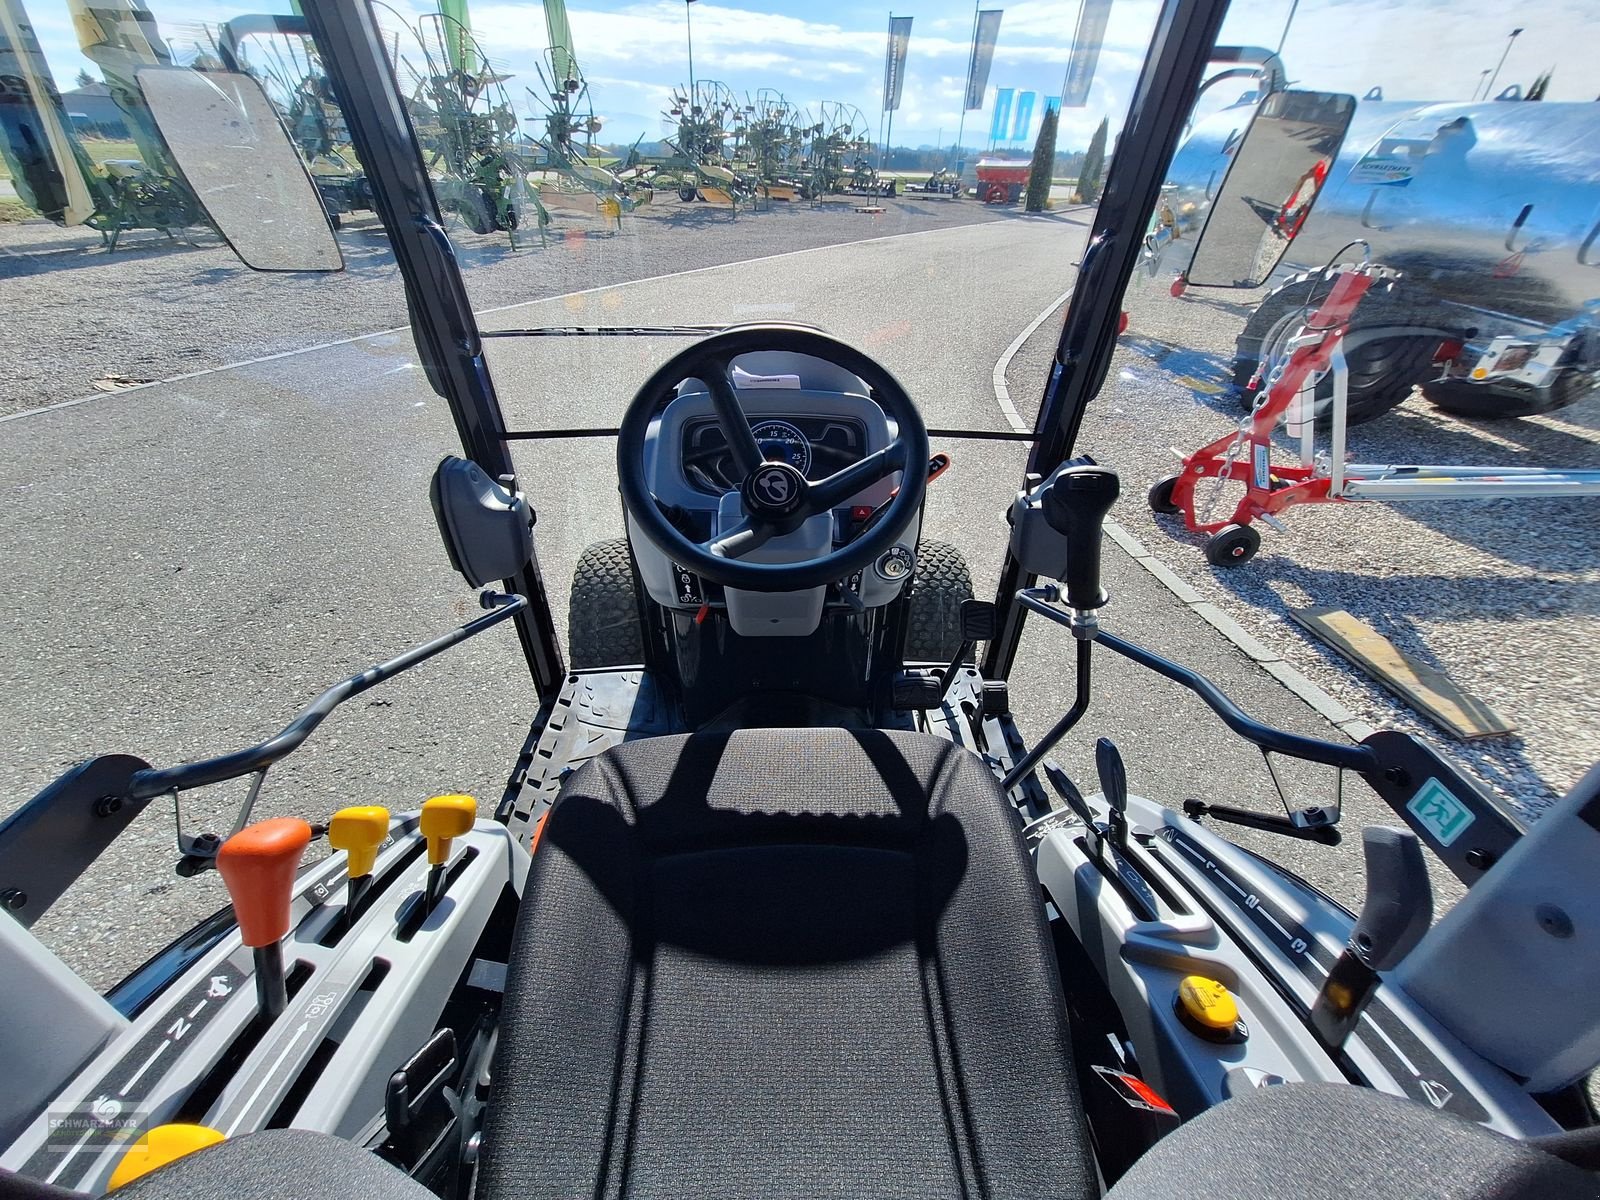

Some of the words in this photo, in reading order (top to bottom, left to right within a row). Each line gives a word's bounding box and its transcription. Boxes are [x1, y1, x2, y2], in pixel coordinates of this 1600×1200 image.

[1245, 894, 1259, 909] 2
[1291, 938, 1307, 954] 3
[167, 1017, 192, 1040] N
